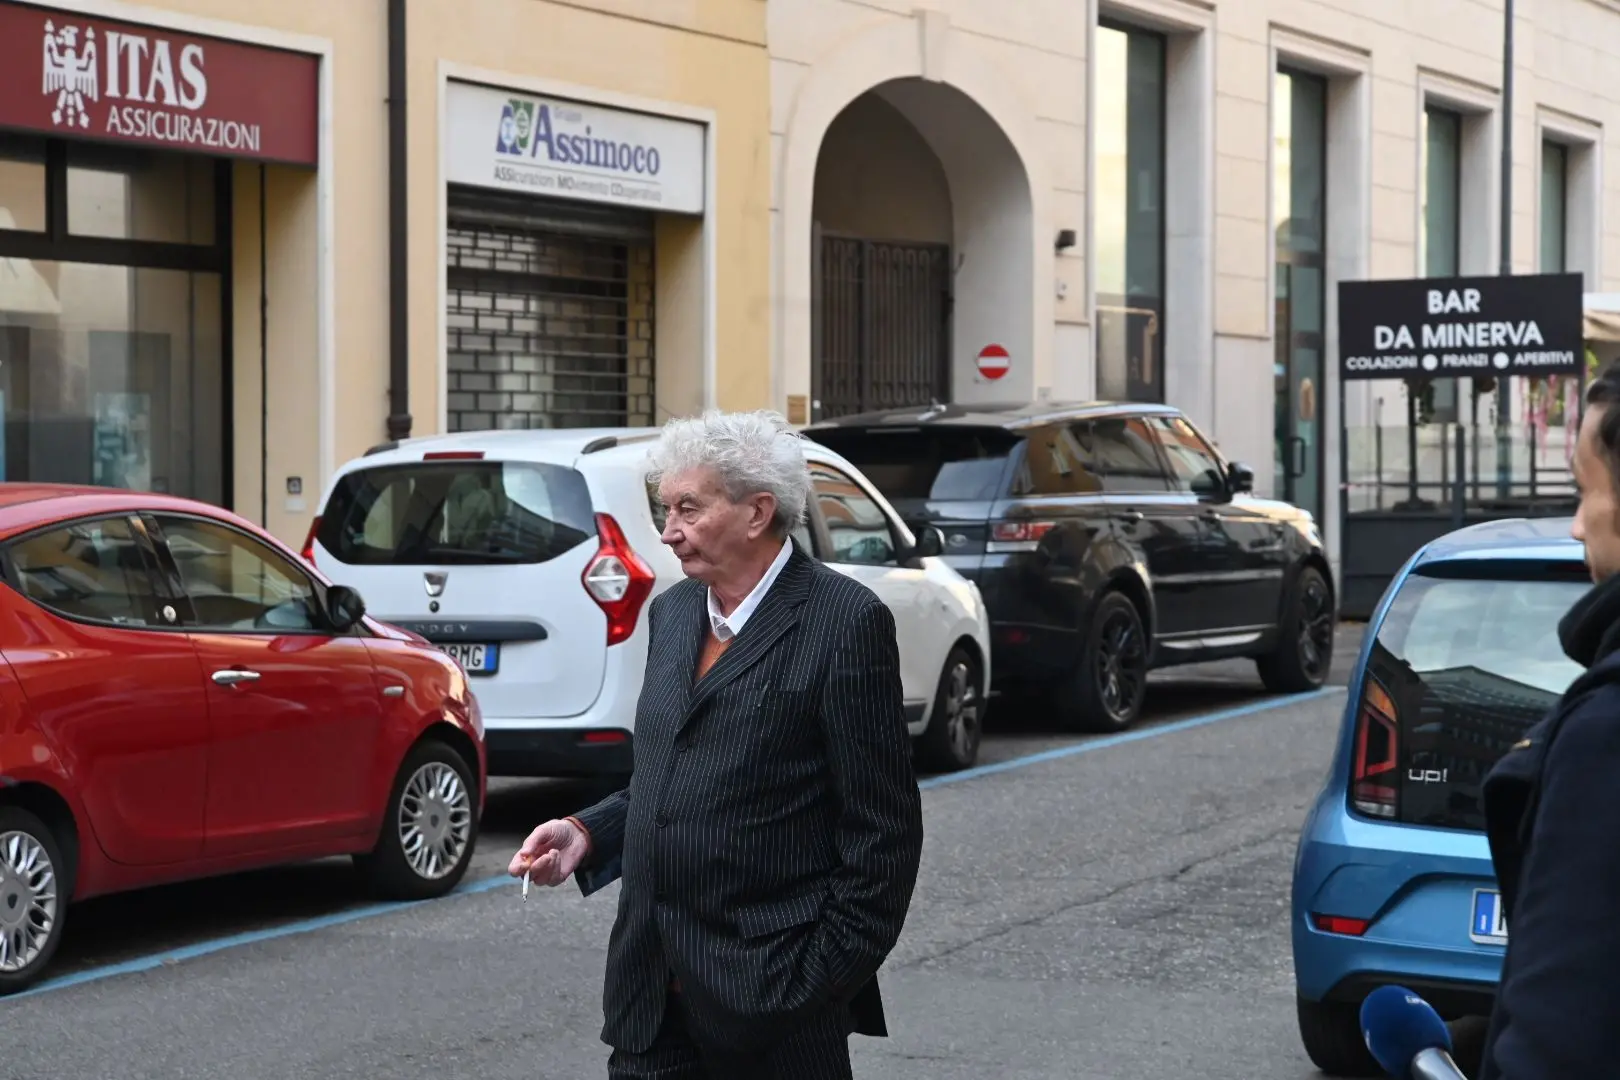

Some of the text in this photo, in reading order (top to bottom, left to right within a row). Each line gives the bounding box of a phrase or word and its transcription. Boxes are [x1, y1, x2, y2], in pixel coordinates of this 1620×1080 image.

[104, 31, 207, 110] ITAS
[106, 105, 261, 151] ASSICURAZIONI
[531, 104, 660, 176] Assimoco
[1427, 288, 1481, 314] BAR
[1374, 320, 1544, 350] DA MINERVA
[1346, 350, 1574, 371] COLAZIONI PRANZI APERITIVI
[1408, 768, 1448, 784] up!
